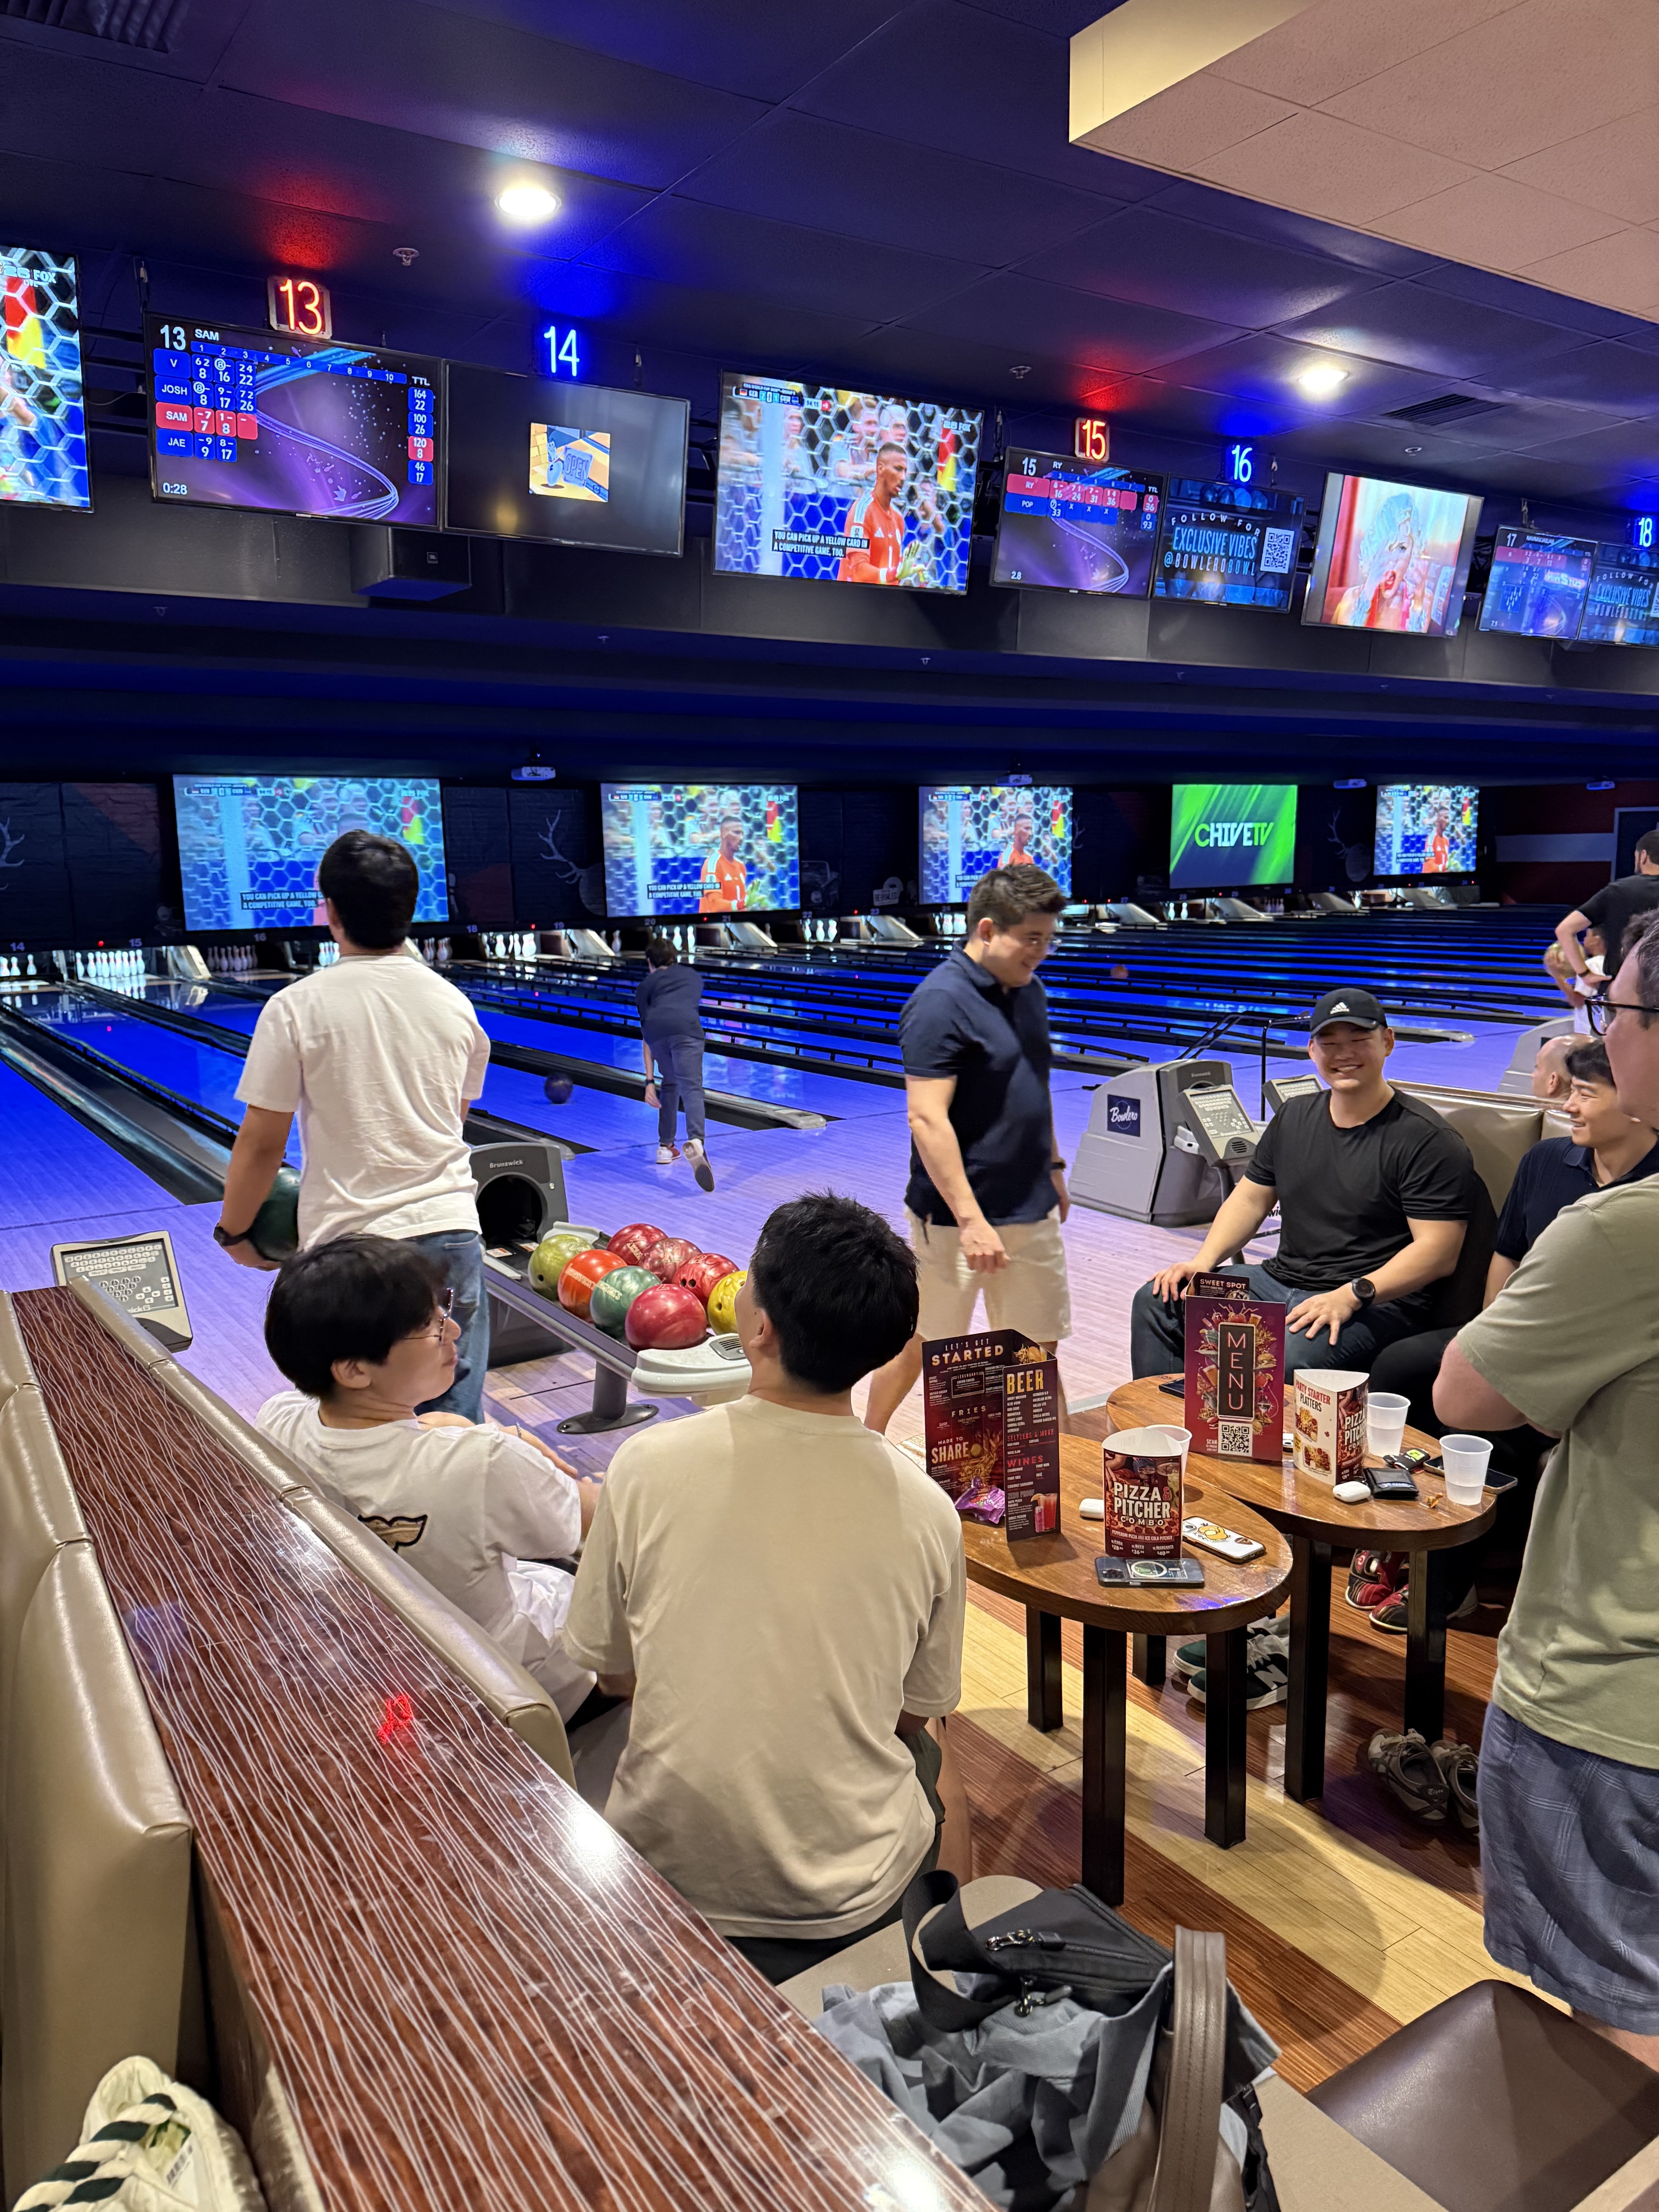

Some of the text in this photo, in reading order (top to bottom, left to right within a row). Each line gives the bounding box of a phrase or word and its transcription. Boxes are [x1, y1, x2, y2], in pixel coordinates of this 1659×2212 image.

[33, 269, 56, 283] FOX
[279, 278, 322, 335] 13
[160, 325, 219, 350] 13 SAM
[544, 326, 580, 376] 14
[170, 359, 177, 367] V
[199, 368, 425, 410] 8 16 22 22
[412, 376, 430, 386] TTL
[161, 384, 187, 395] JOSH
[414, 414, 427, 423] 100
[414, 389, 426, 399] 164
[200, 395, 425, 434] 8 17 26 26
[166, 411, 426, 447] SAM 120
[1082, 419, 1106, 460] 15
[201, 421, 423, 459] 7 8 8
[168, 438, 425, 471] JAE 46
[201, 447, 424, 483] 9 17 17
[1231, 444, 1253, 482] 16
[565, 456, 590, 482] OPEN
[1022, 457, 1037, 476] 15
[163, 483, 187, 495] 0:28
[1055, 489, 1154, 512] 16 24 31 36 36
[1051, 508, 1152, 529] 33 93
[1171, 513, 1260, 536] FOLLOW FOR
[775, 531, 868, 548] YOU CAN PICK UP A YELLOW CARD IN
[1506, 533, 1517, 547] 17
[1638, 517, 1652, 547] 18
[774, 542, 844, 557] A COMPETITIVE GAME, TOO.
[1173, 527, 1257, 560] EXCLUSIVE VIBES
[1164, 551, 1255, 576] @BOWLEROBOWL
[1596, 572, 1633, 582] FOLLOW
[1595, 583, 1650, 608] EXCLUSIVE VIBES
[1195, 823, 1274, 847] CHIVETV
[254, 933, 266, 942] 16
[466, 924, 478, 933] 18
[10, 942, 25, 951] 14
[129, 938, 142, 947] 15
[1110, 1105, 1138, 1123] Bowlero
[489, 1159, 524, 1168] Brunswick
[932, 1345, 1003, 1366] STARTED
[945, 1341, 968, 1351] LET'S
[1007, 1369, 1044, 1394] BEER
[1227, 1332, 1246, 1410] MENU
[1296, 1379, 1330, 1405] PARTY STARTER
[951, 1406, 986, 1417] FRIES
[1300, 1394, 1322, 1412] PLATTERS
[1007, 1432, 1032, 1441] SELTZERS
[932, 1442, 969, 1464] SHARE
[1007, 1455, 1043, 1467] WINES
[1114, 1482, 1172, 1501] PIZZA &
[1114, 1497, 1170, 1518] PITCHER
[1120, 1516, 1164, 1526] COMBO
